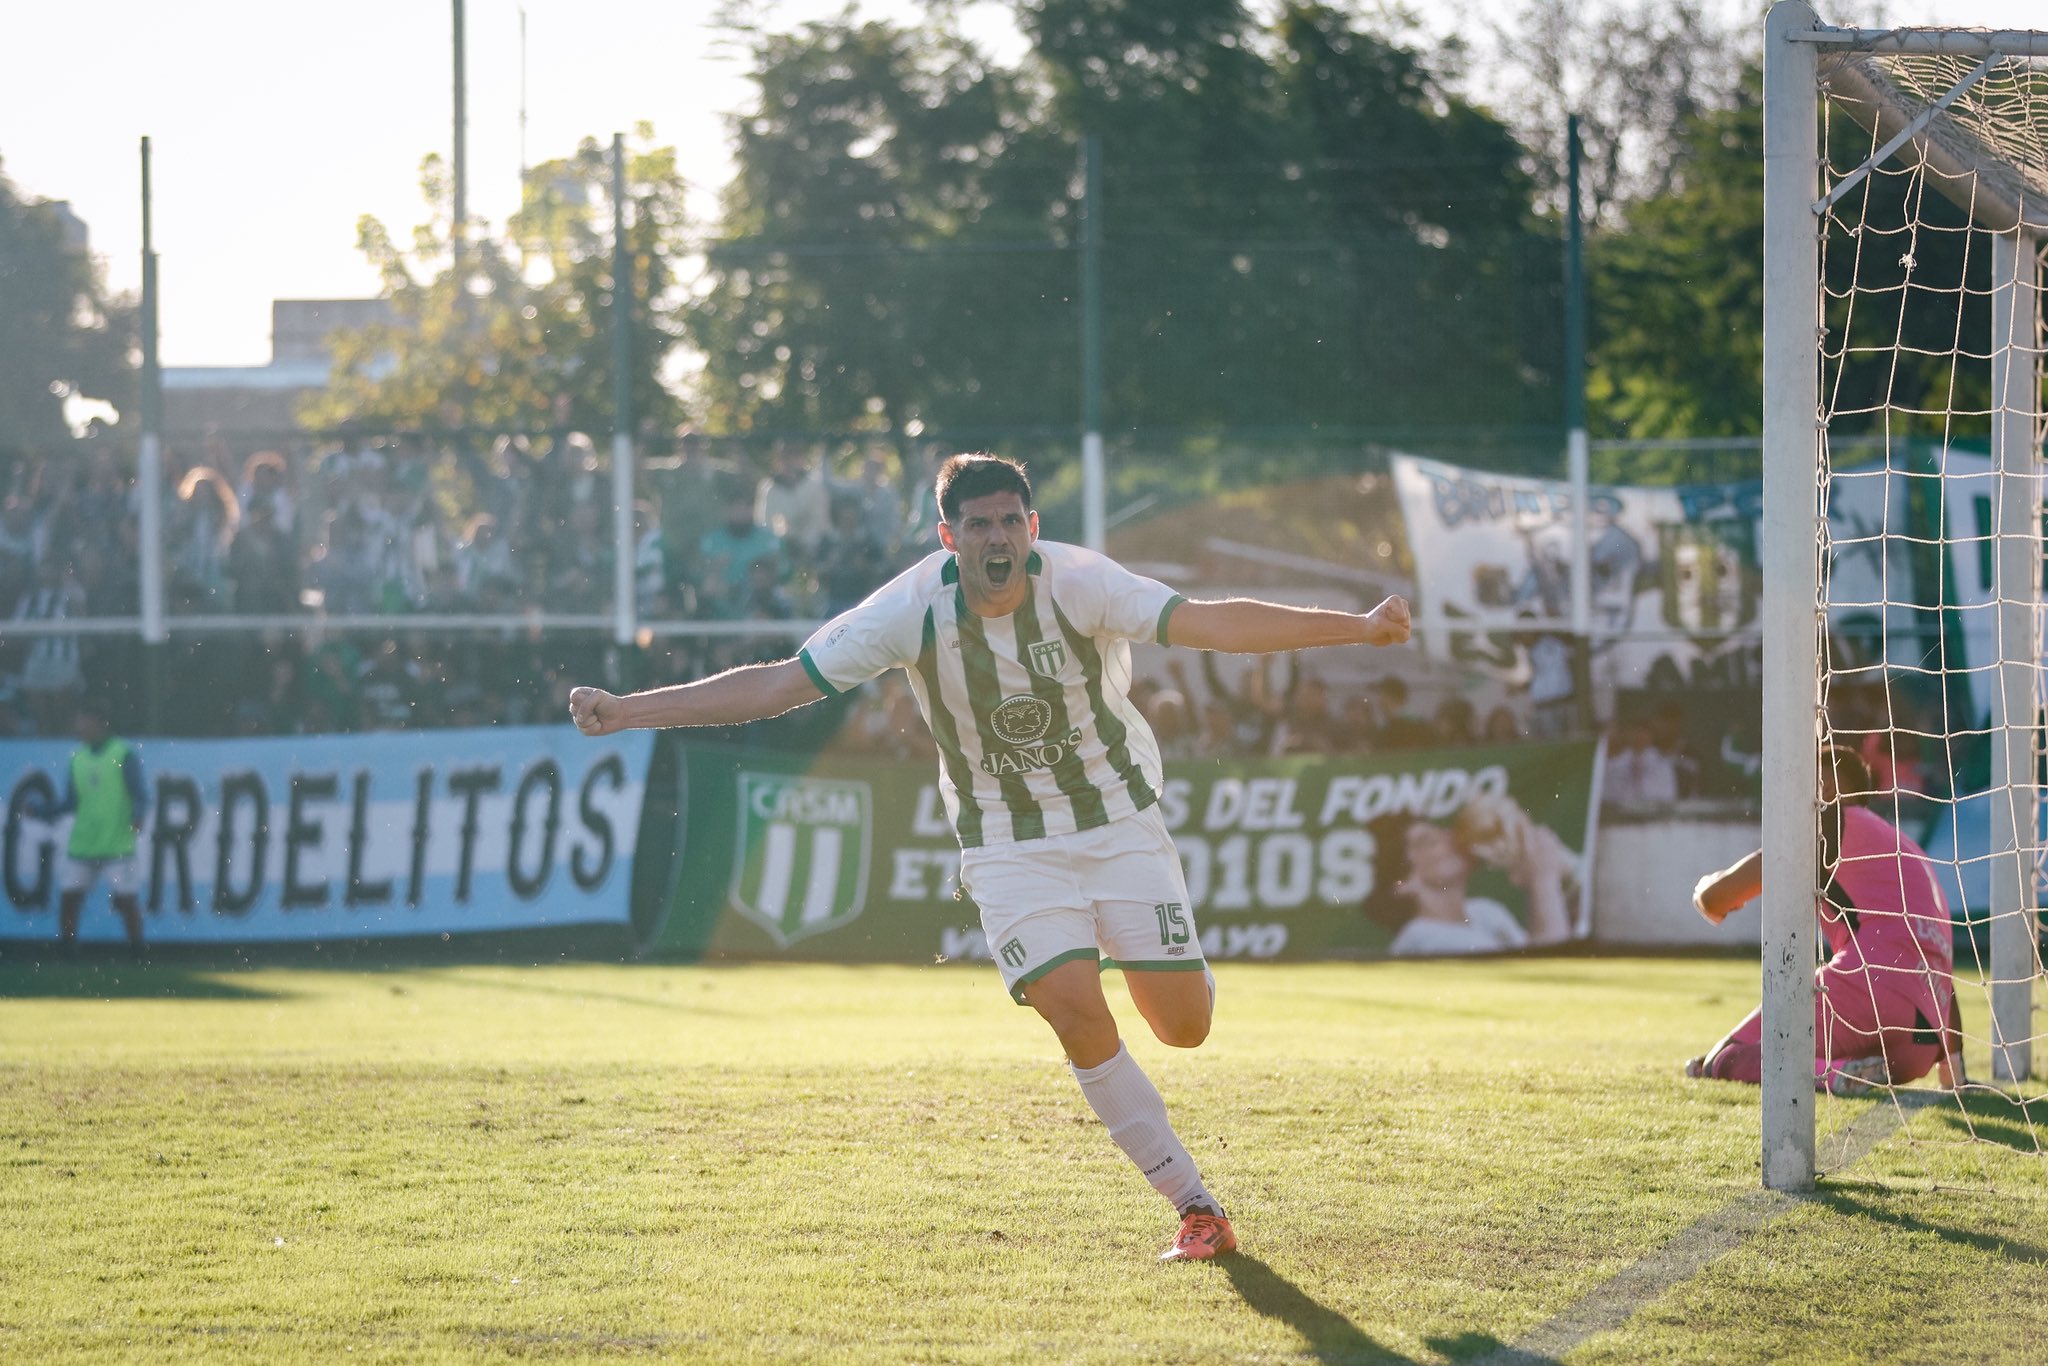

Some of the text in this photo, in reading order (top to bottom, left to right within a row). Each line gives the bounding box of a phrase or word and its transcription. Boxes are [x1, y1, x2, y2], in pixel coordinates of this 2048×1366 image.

[1034, 642, 1061, 655] CASM
[1203, 778, 1304, 831] DEL
[1318, 765, 1509, 827] FONDO
[3, 753, 626, 914] GRDELITOS
[1154, 902, 1190, 946] 15
[1199, 923, 1288, 958] AYO
